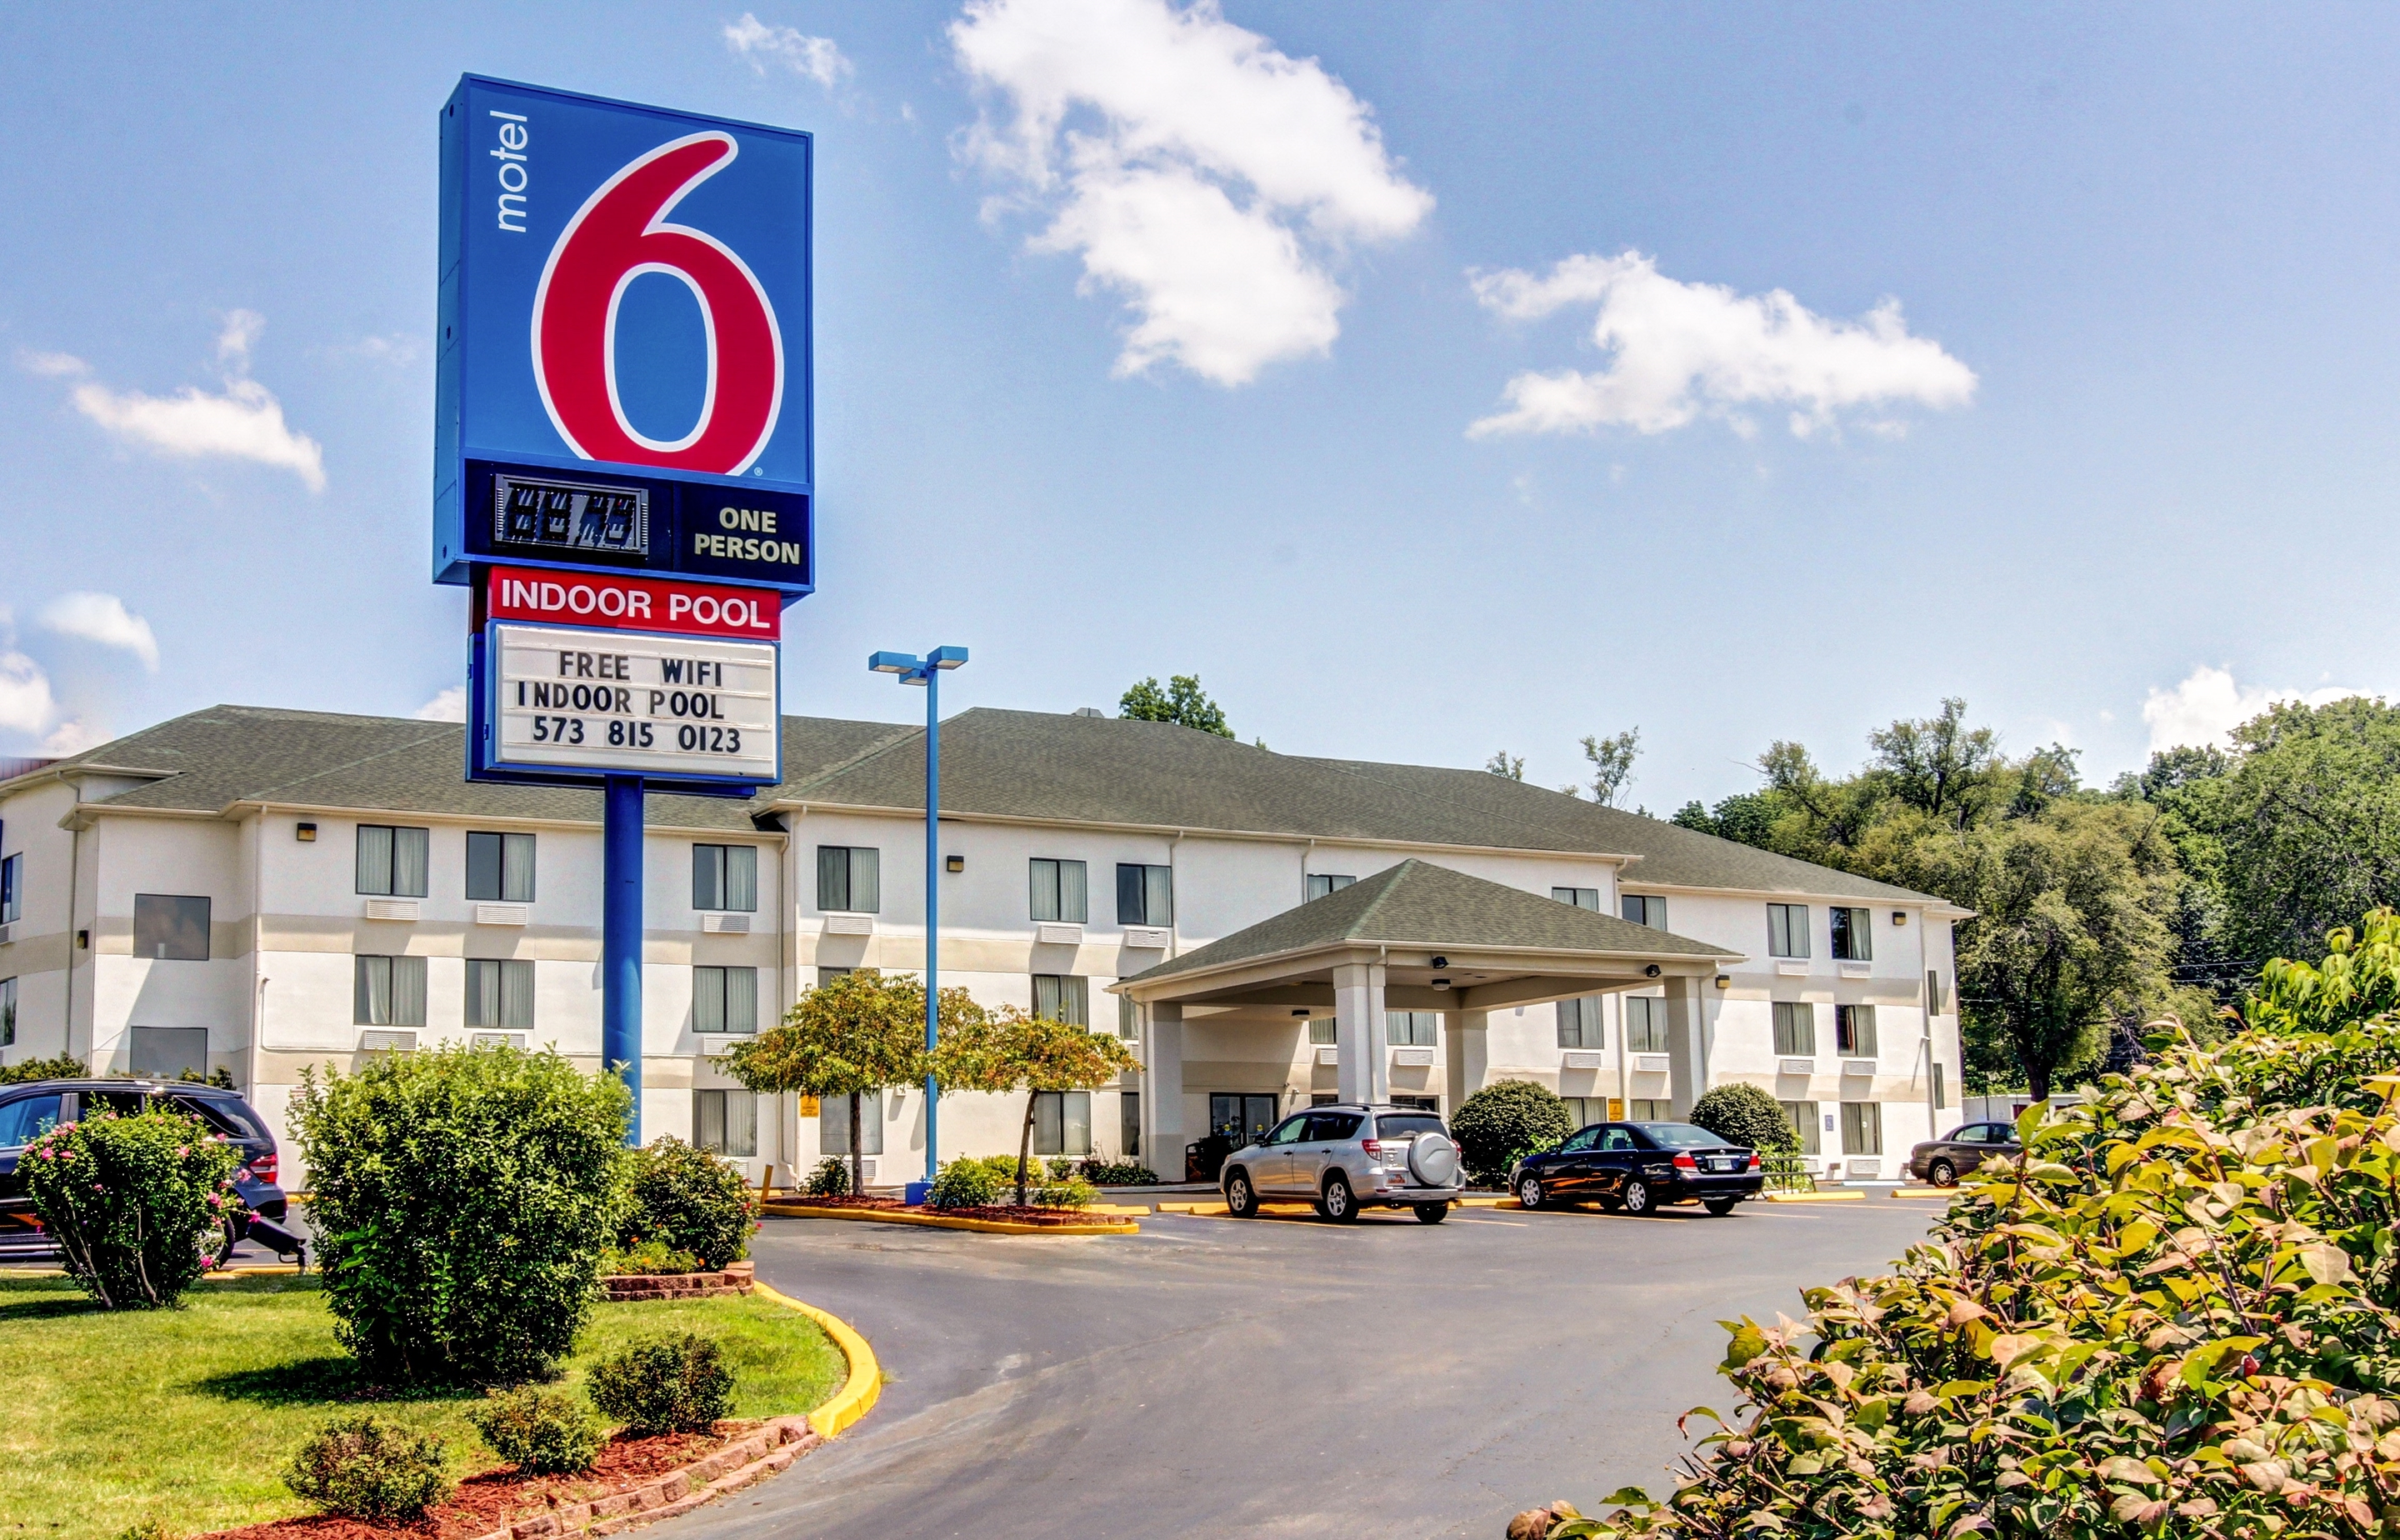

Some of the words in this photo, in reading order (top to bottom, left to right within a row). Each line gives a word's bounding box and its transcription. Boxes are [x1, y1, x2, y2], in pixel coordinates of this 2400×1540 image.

[490, 111, 528, 232] motel
[531, 130, 784, 476] 6
[719, 507, 777, 533] ONE
[694, 532, 800, 565] PERSON
[502, 579, 652, 619] INDOOR
[669, 593, 771, 629] POOL
[559, 651, 630, 680] FREE
[662, 658, 722, 688] WIFI
[518, 681, 631, 713] INDOOR
[649, 690, 724, 719] POOL
[533, 716, 584, 744] 573
[608, 720, 653, 748] 815
[678, 724, 741, 753] 0123
